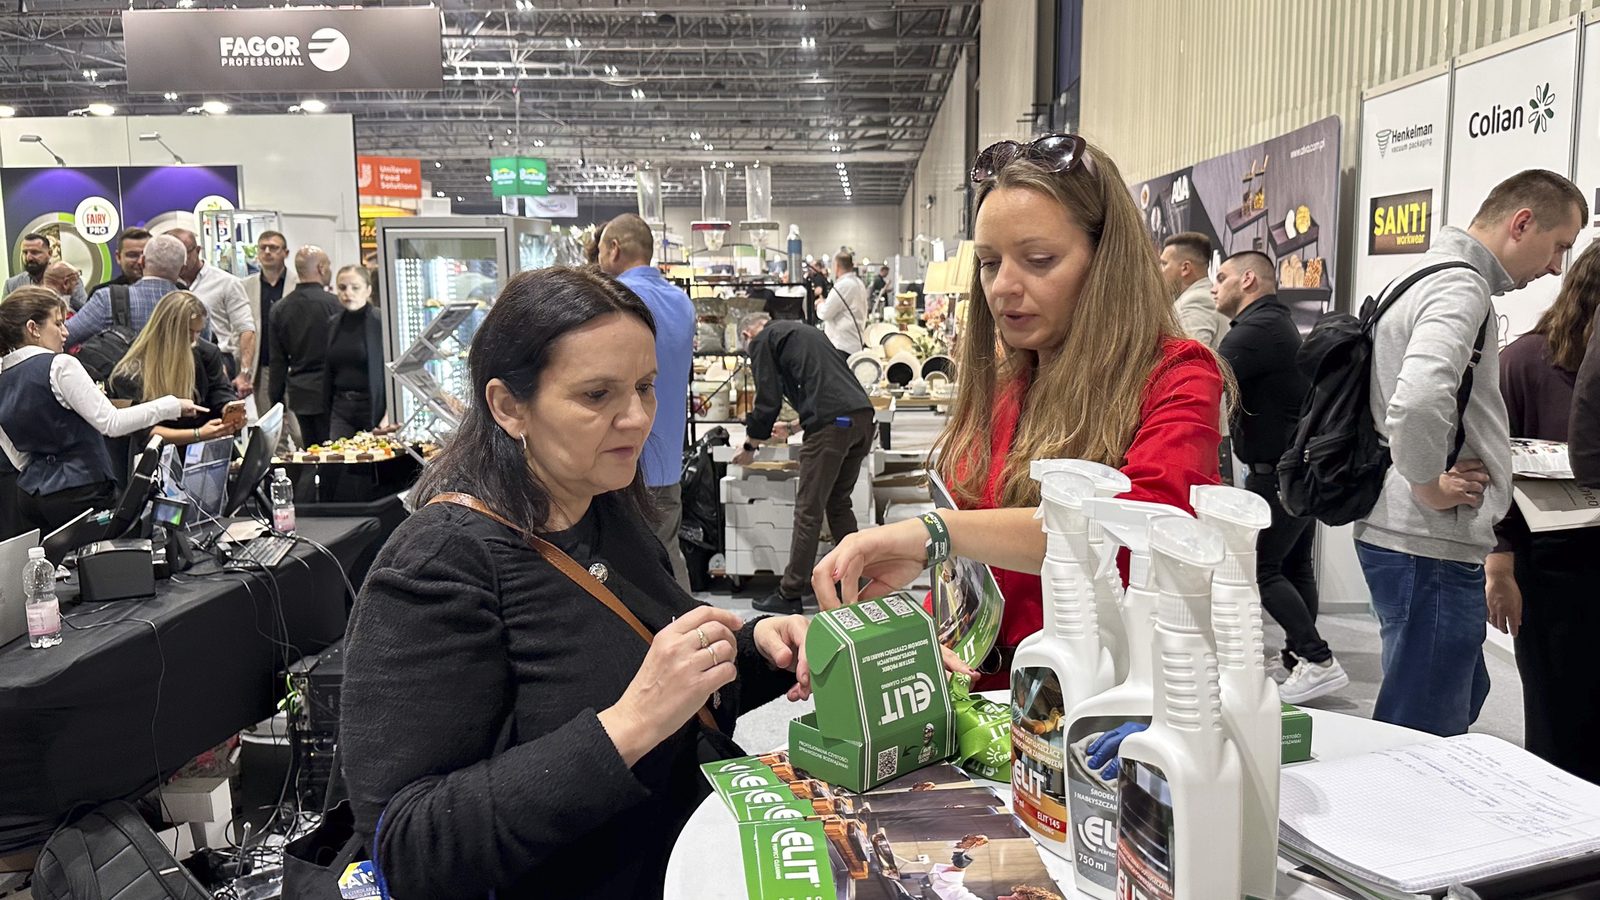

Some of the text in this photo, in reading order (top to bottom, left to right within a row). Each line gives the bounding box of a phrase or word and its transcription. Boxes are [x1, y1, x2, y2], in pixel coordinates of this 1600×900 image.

[219, 35, 301, 57] FAGOR
[221, 56, 304, 67] PROFESSIONAL
[1468, 104, 1524, 139] Colian
[1391, 122, 1433, 144] Henkelman
[1391, 137, 1433, 153] vacuum packaging
[379, 165, 412, 174] Unilever
[380, 174, 401, 182] Food
[380, 182, 418, 191] Solutions
[86, 213, 106, 224] FAIRY
[1374, 201, 1427, 236] SANTI
[89, 226, 106, 235] PRO
[1396, 234, 1425, 246] workwear
[880, 673, 935, 725] ELIT
[1013, 758, 1045, 799] ELIT
[1090, 788, 1115, 801] ŚRODEK
[1036, 811, 1060, 829] ELIT 145
[772, 827, 820, 885] ELIT
[1078, 852, 1107, 872] 750 ml
